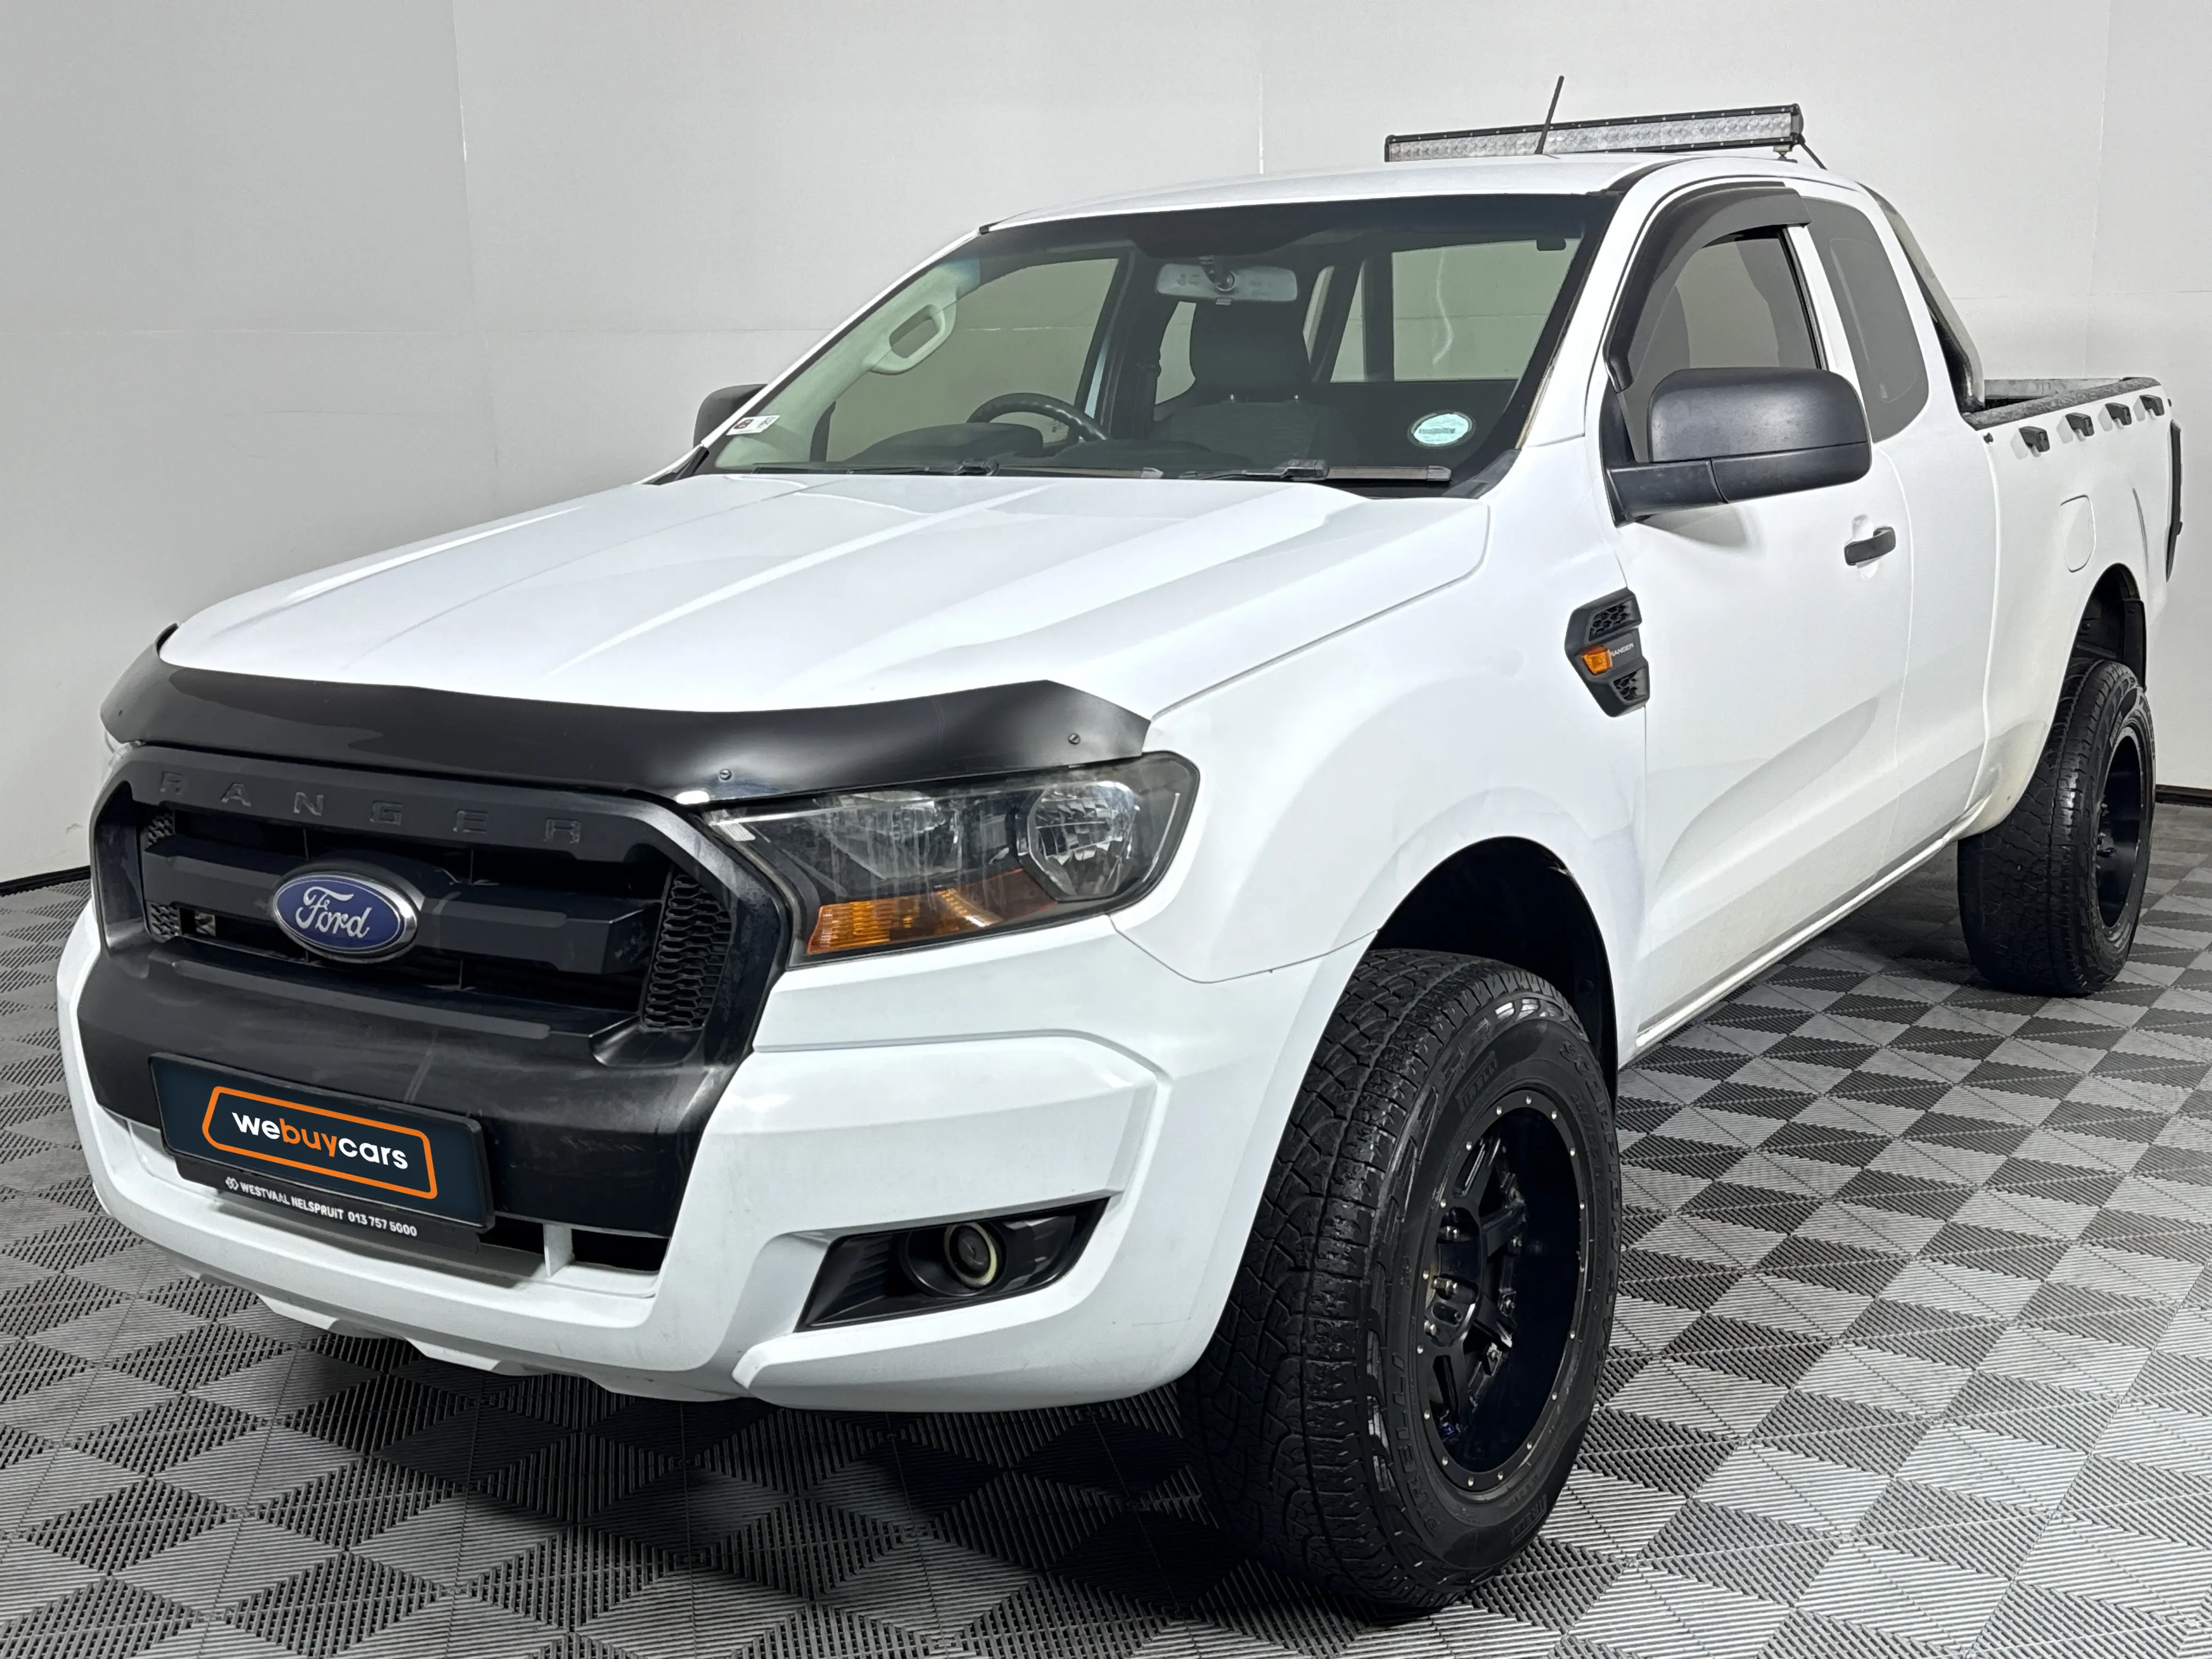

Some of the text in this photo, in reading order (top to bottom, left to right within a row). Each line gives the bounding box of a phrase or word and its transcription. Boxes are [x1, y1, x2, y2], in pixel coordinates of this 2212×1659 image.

[160, 771, 582, 844] RANGER
[295, 886, 373, 939] Ford
[239, 1181, 417, 1237] WESTVAAL NELSPRUIT 013 757 5000
[1391, 1352, 1443, 1538] PIRELLI
